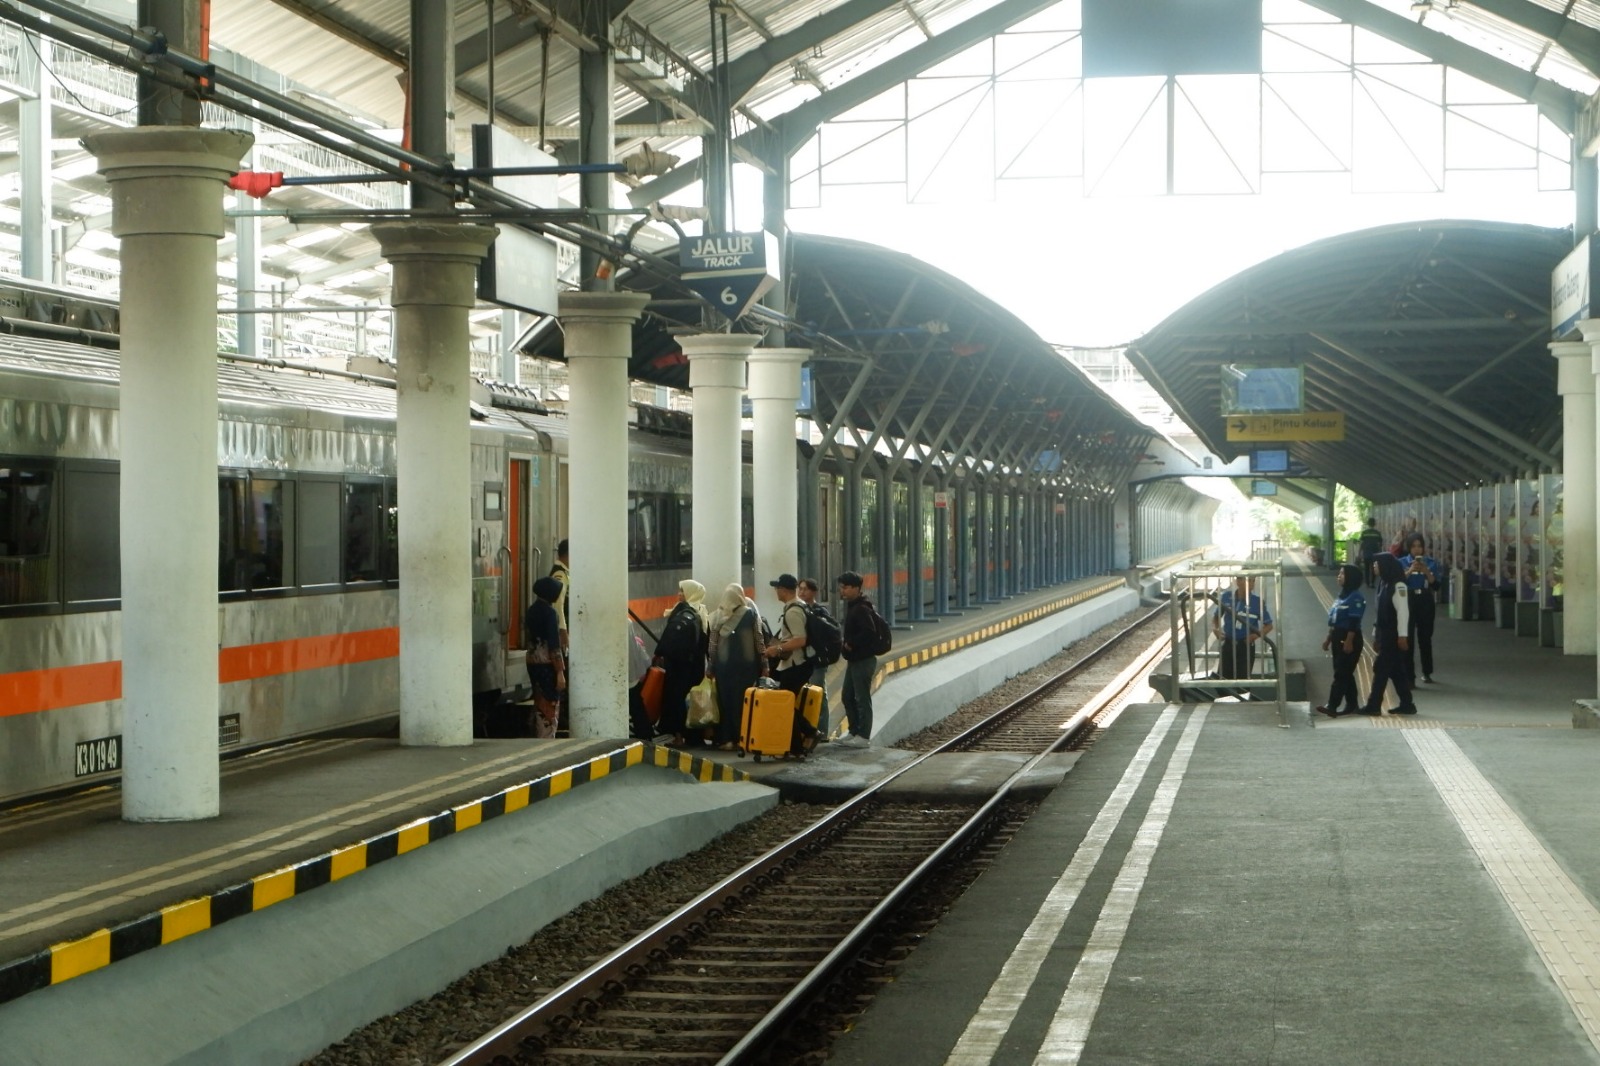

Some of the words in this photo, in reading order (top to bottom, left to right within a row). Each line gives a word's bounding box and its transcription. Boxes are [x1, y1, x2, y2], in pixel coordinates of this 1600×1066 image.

[691, 236, 753, 256] JALUR
[703, 256, 742, 268] TRACK
[720, 286, 738, 305] 6
[1273, 418, 1300, 428] Pintu
[1303, 418, 1337, 428] Keluar
[76, 744, 88, 775] K3
